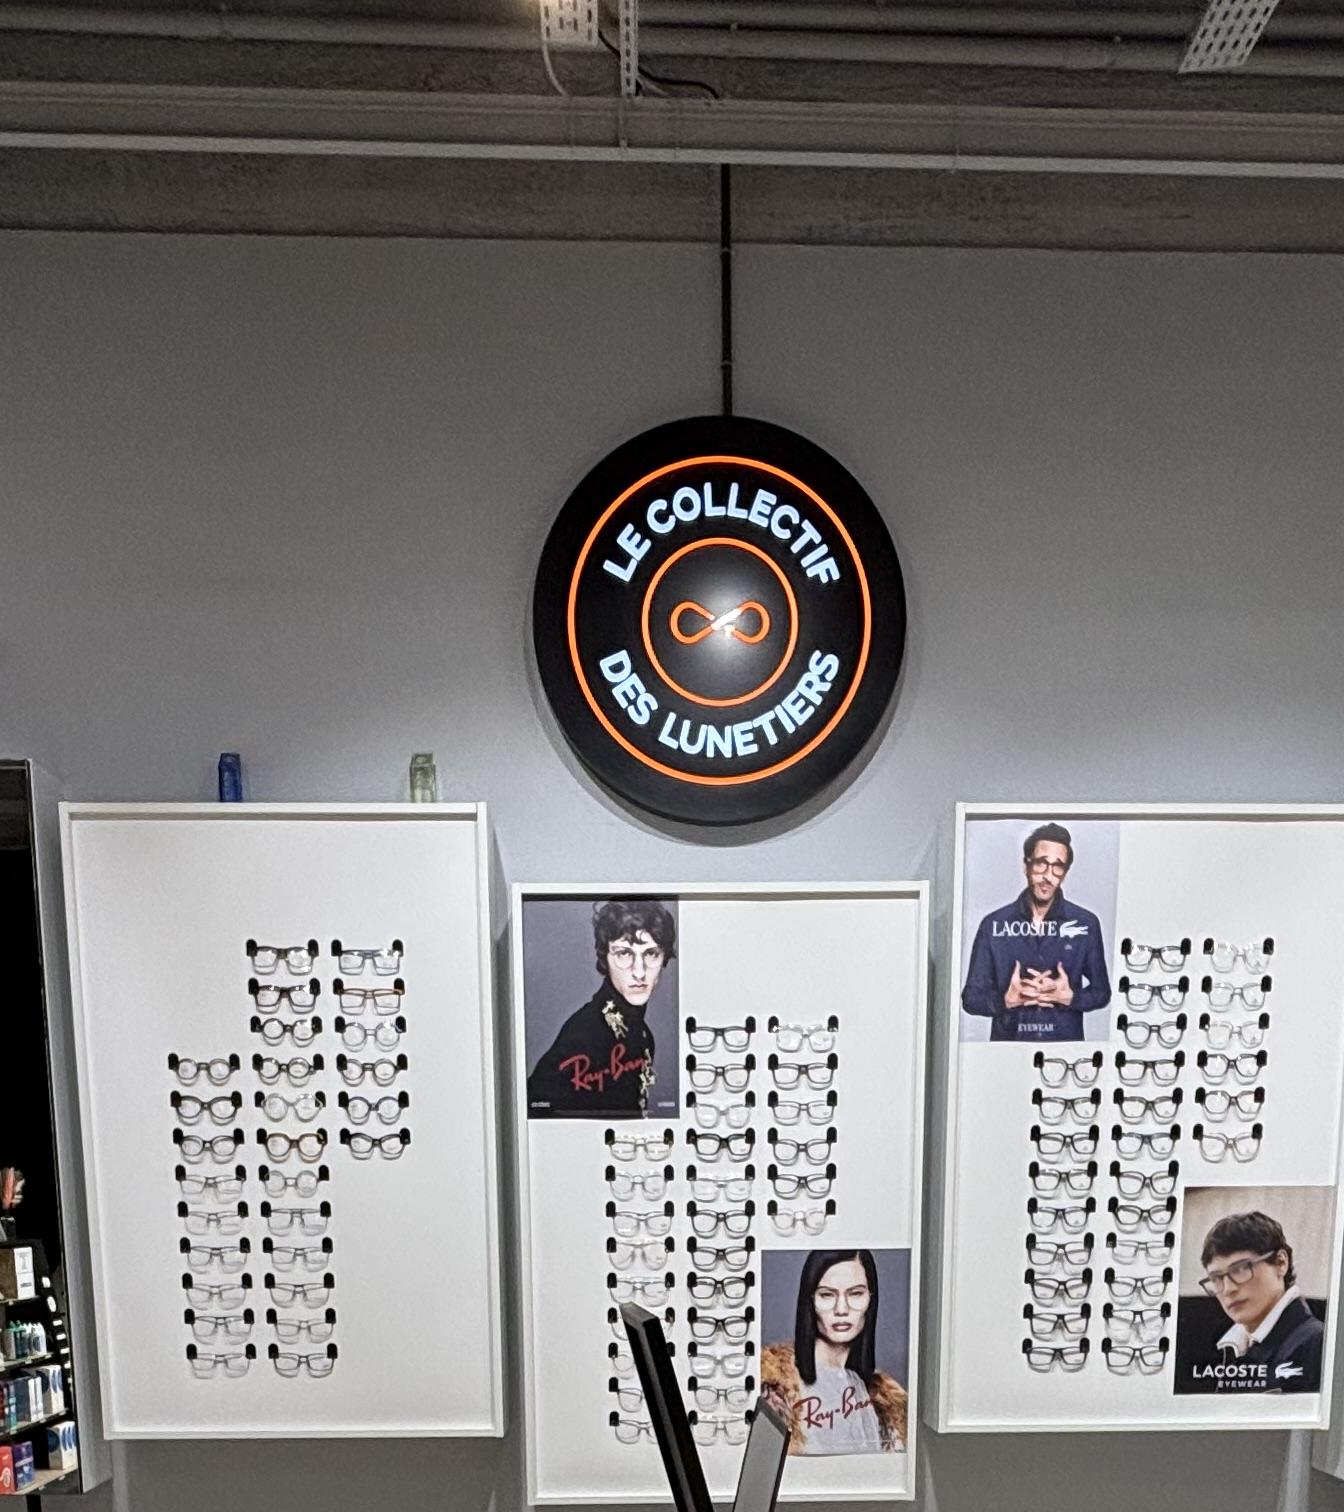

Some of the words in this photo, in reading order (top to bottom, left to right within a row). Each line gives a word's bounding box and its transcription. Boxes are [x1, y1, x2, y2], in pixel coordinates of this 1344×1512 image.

[603, 523, 652, 583] LE
[646, 482, 841, 585] COLLECTIF
[599, 650, 659, 726] DES
[658, 650, 840, 758] LUNETIERS
[992, 920, 1058, 937] LACOSTE
[1018, 1023, 1054, 1032] EYEWEAR
[558, 1043, 648, 1092] Ray-Ban
[1192, 1364, 1268, 1379] LACOSTE
[1217, 1380, 1267, 1388] EYEWEAR
[792, 1386, 874, 1430] Ray-Ban
